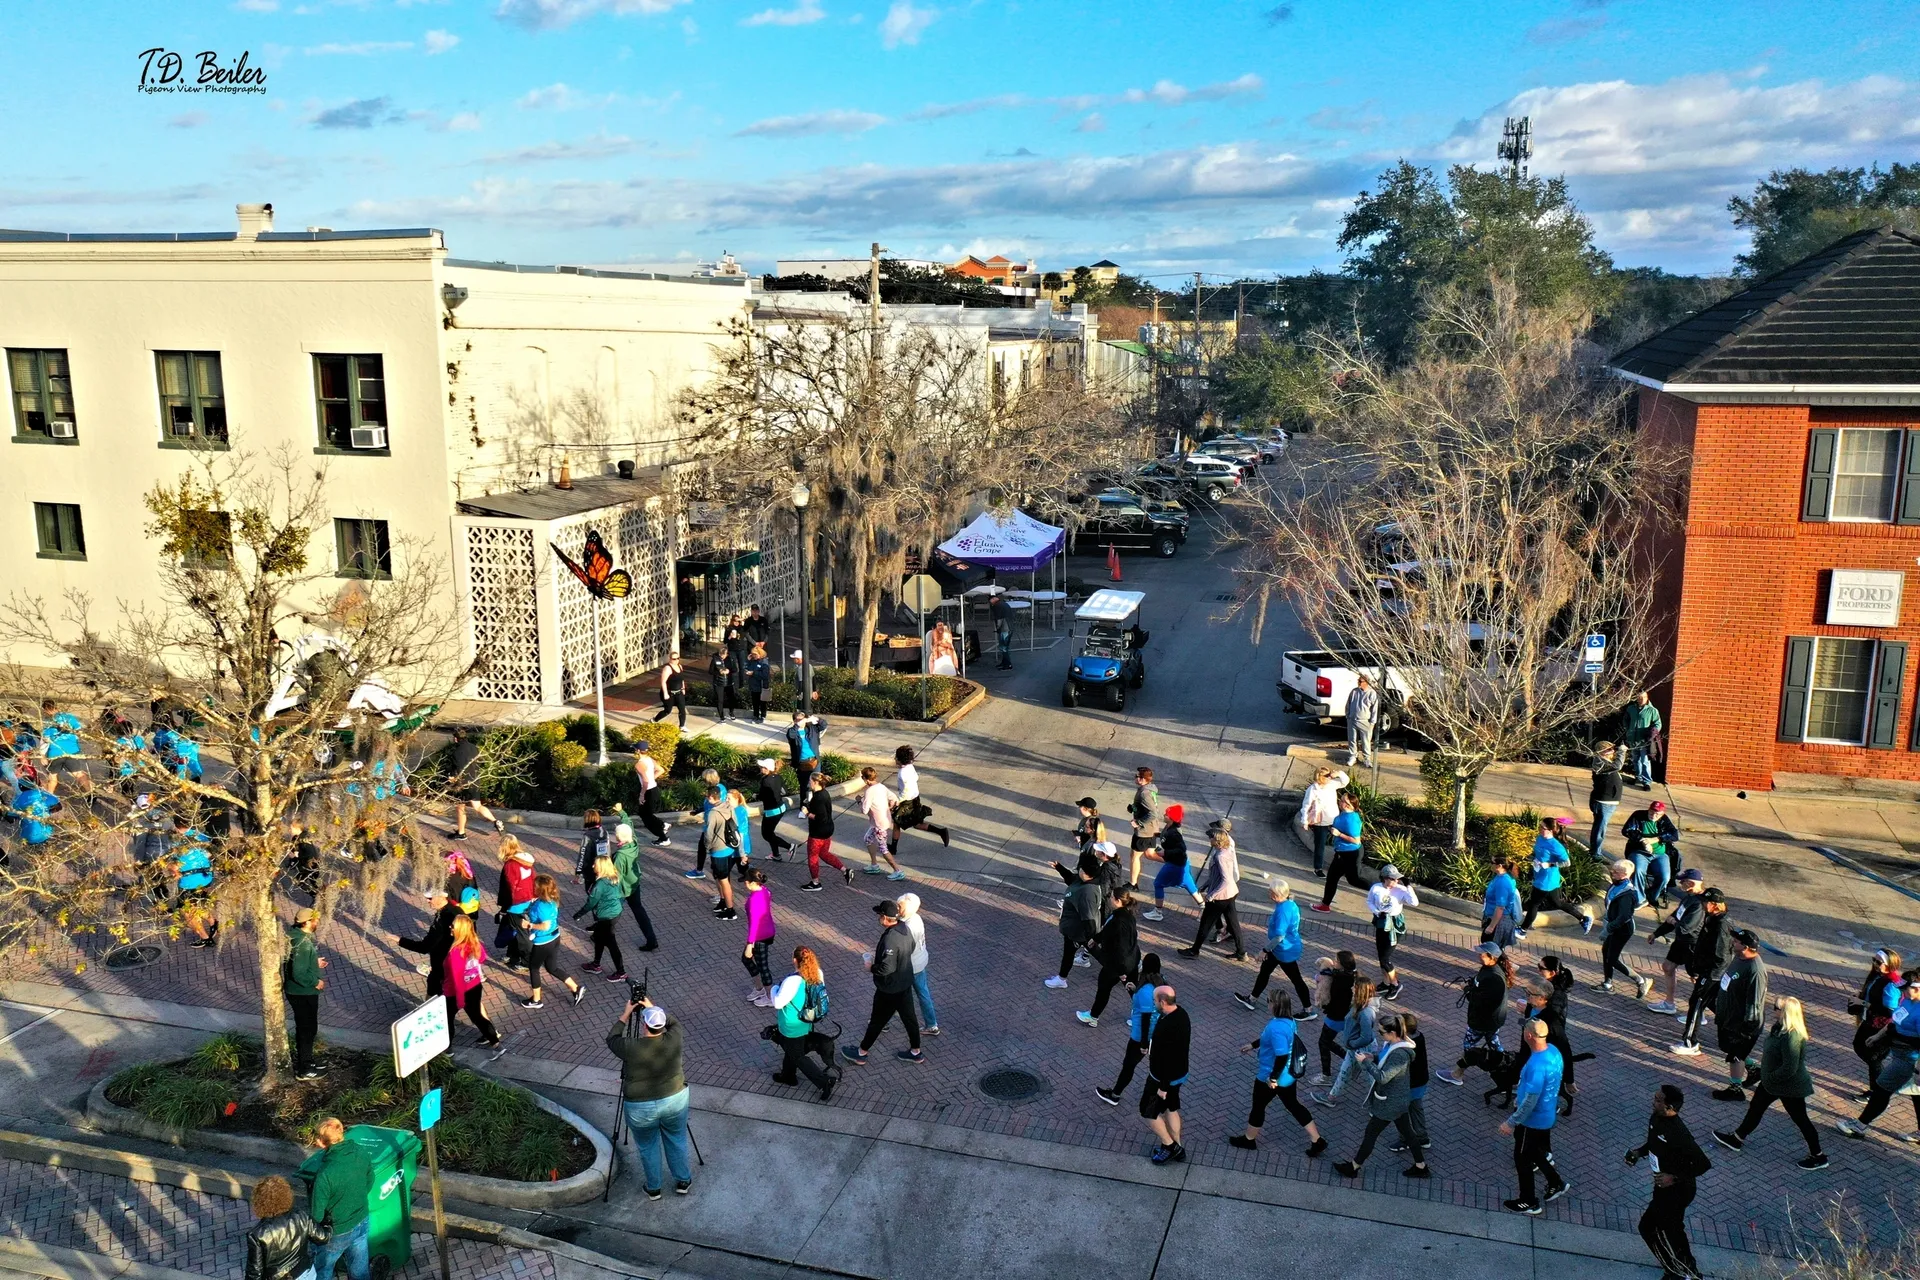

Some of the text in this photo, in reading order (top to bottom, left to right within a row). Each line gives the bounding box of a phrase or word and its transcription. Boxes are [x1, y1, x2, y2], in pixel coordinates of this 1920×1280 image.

[974, 539, 1003, 548] Elusive
[974, 546, 1001, 554] Grape
[1838, 586, 1894, 602] FORD
[1836, 600, 1892, 610] PROPERTIES
[417, 1003, 444, 1025] PUBLC
[414, 1021, 445, 1043] PARKNG
